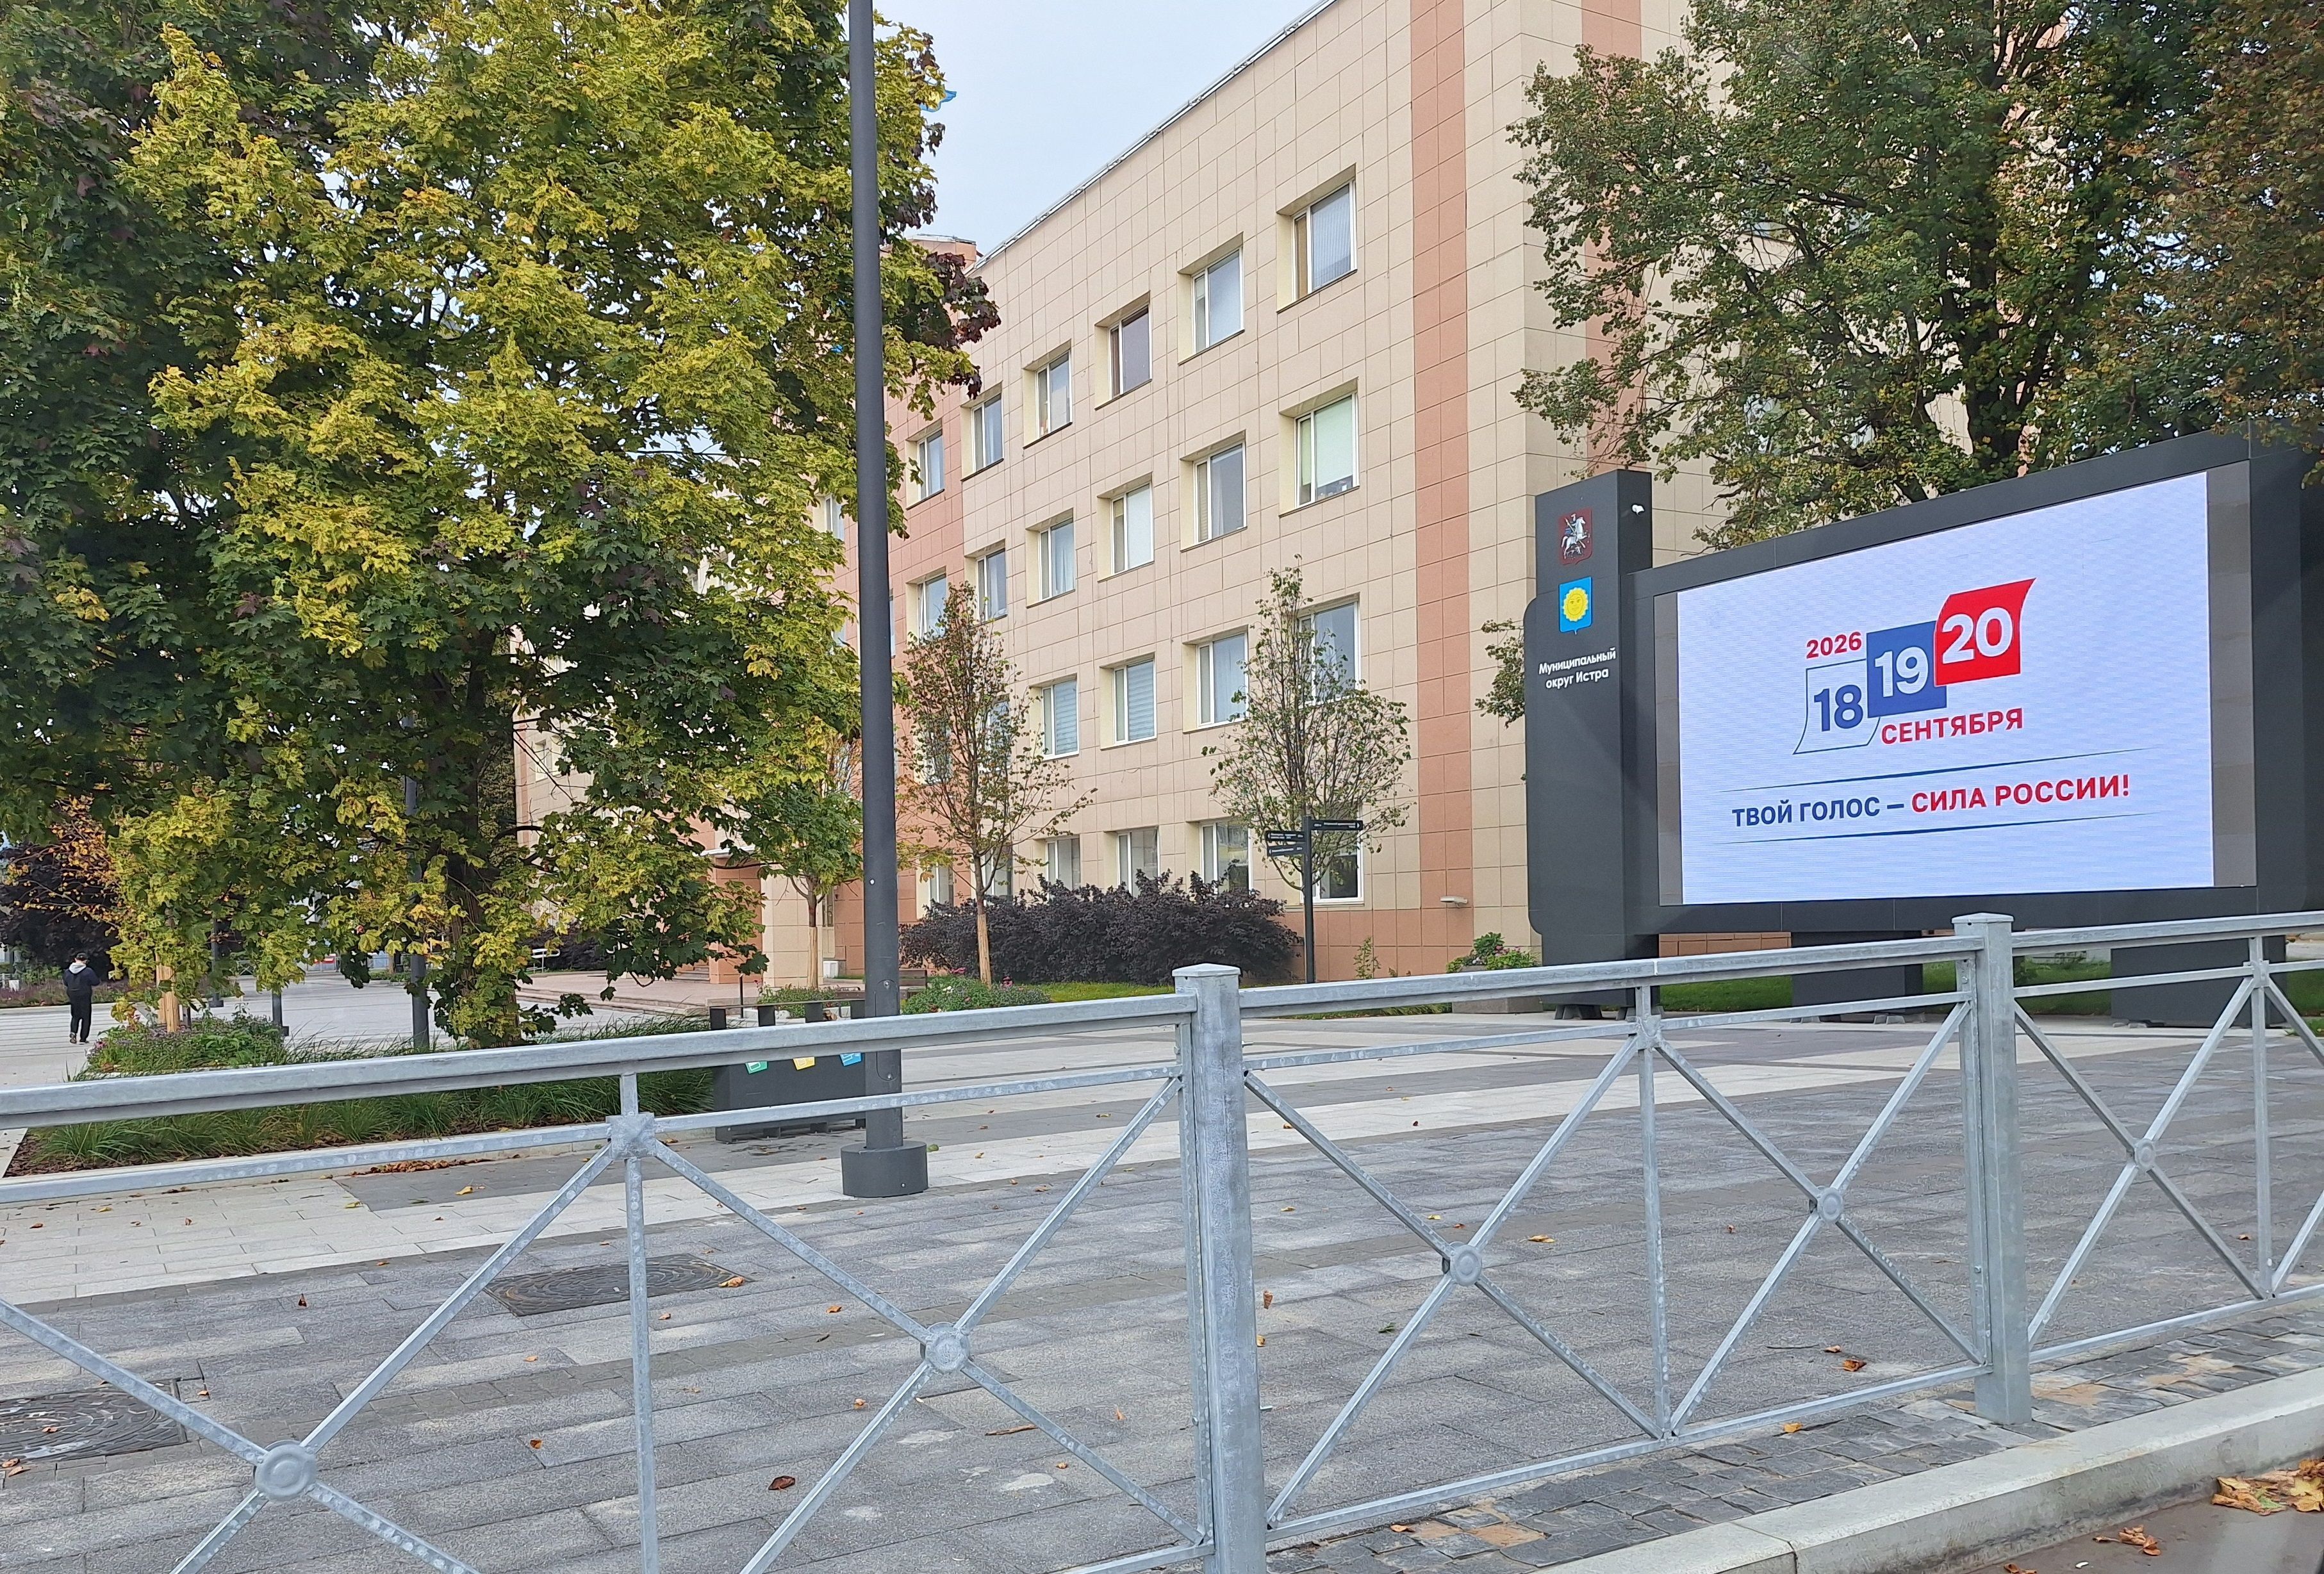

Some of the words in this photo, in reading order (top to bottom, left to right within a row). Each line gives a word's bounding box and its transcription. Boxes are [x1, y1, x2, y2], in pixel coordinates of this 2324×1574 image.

[1538, 647, 1616, 675] Муниципальный
[1806, 631, 1863, 659] 2026
[1545, 675, 1574, 689] округ
[1576, 668, 1609, 683] Истра
[1813, 684, 1865, 732] 18
[1873, 645, 1929, 698] 19
[1941, 606, 2013, 664] 20
[1881, 707, 2023, 745] СЕНТЯБРЯ
[1732, 799, 1792, 827] ТВОЙ
[1799, 795, 1881, 823] ГОЛОС
[1911, 786, 1988, 814] СИЛА
[1995, 773, 2130, 807] РОССИИ!
